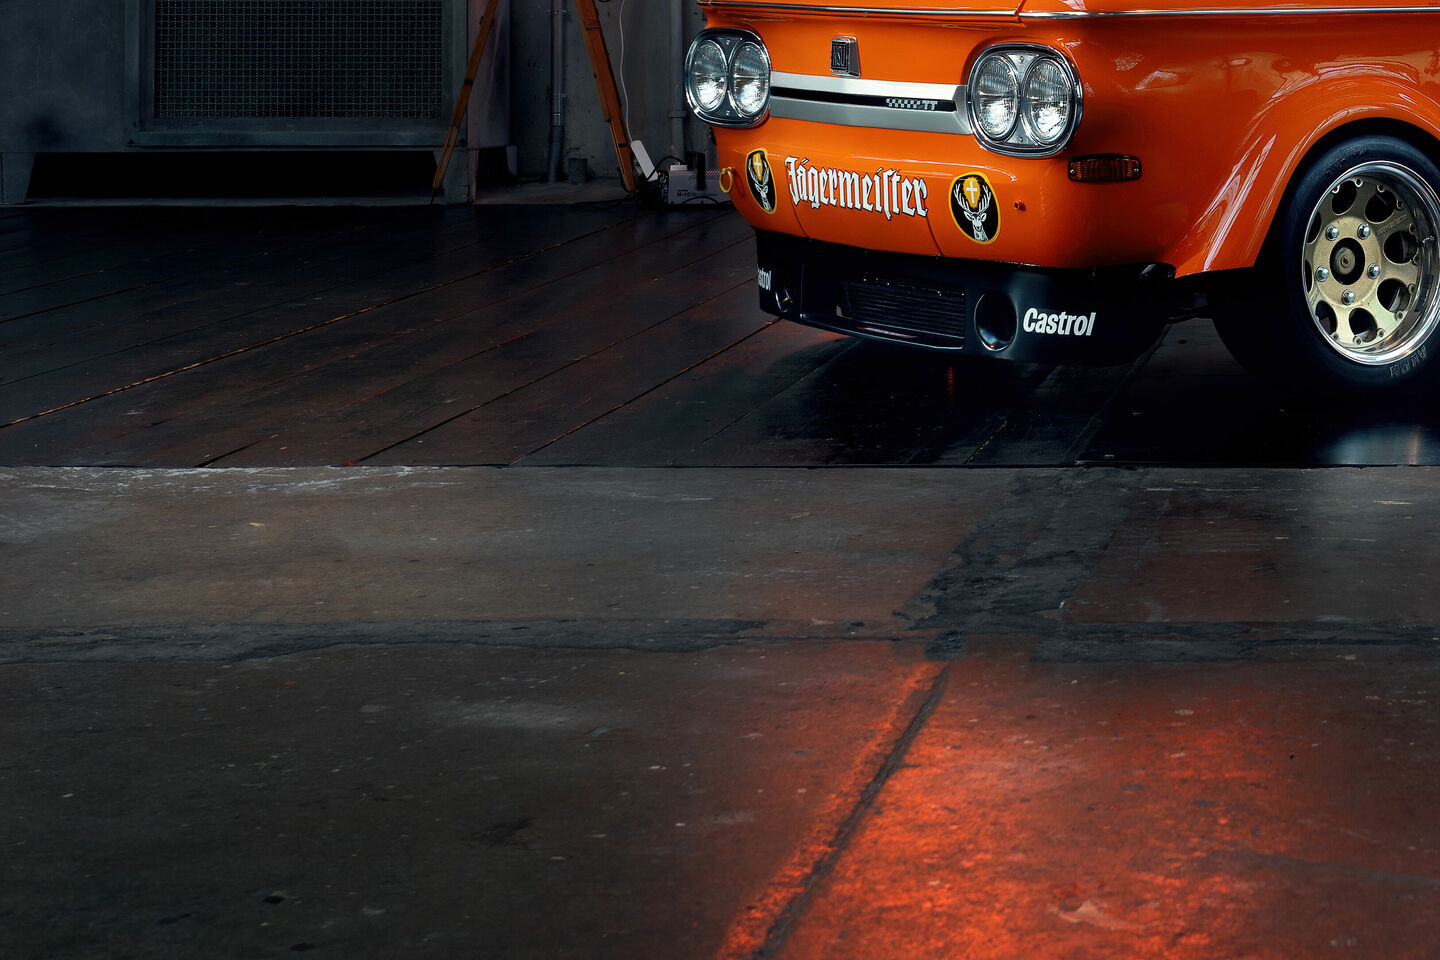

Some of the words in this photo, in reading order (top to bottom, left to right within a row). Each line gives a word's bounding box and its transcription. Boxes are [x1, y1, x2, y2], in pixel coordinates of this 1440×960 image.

[832, 44, 847, 68] NSU
[785, 156, 928, 221] Jägermeister
[1023, 307, 1097, 336] Castrol
